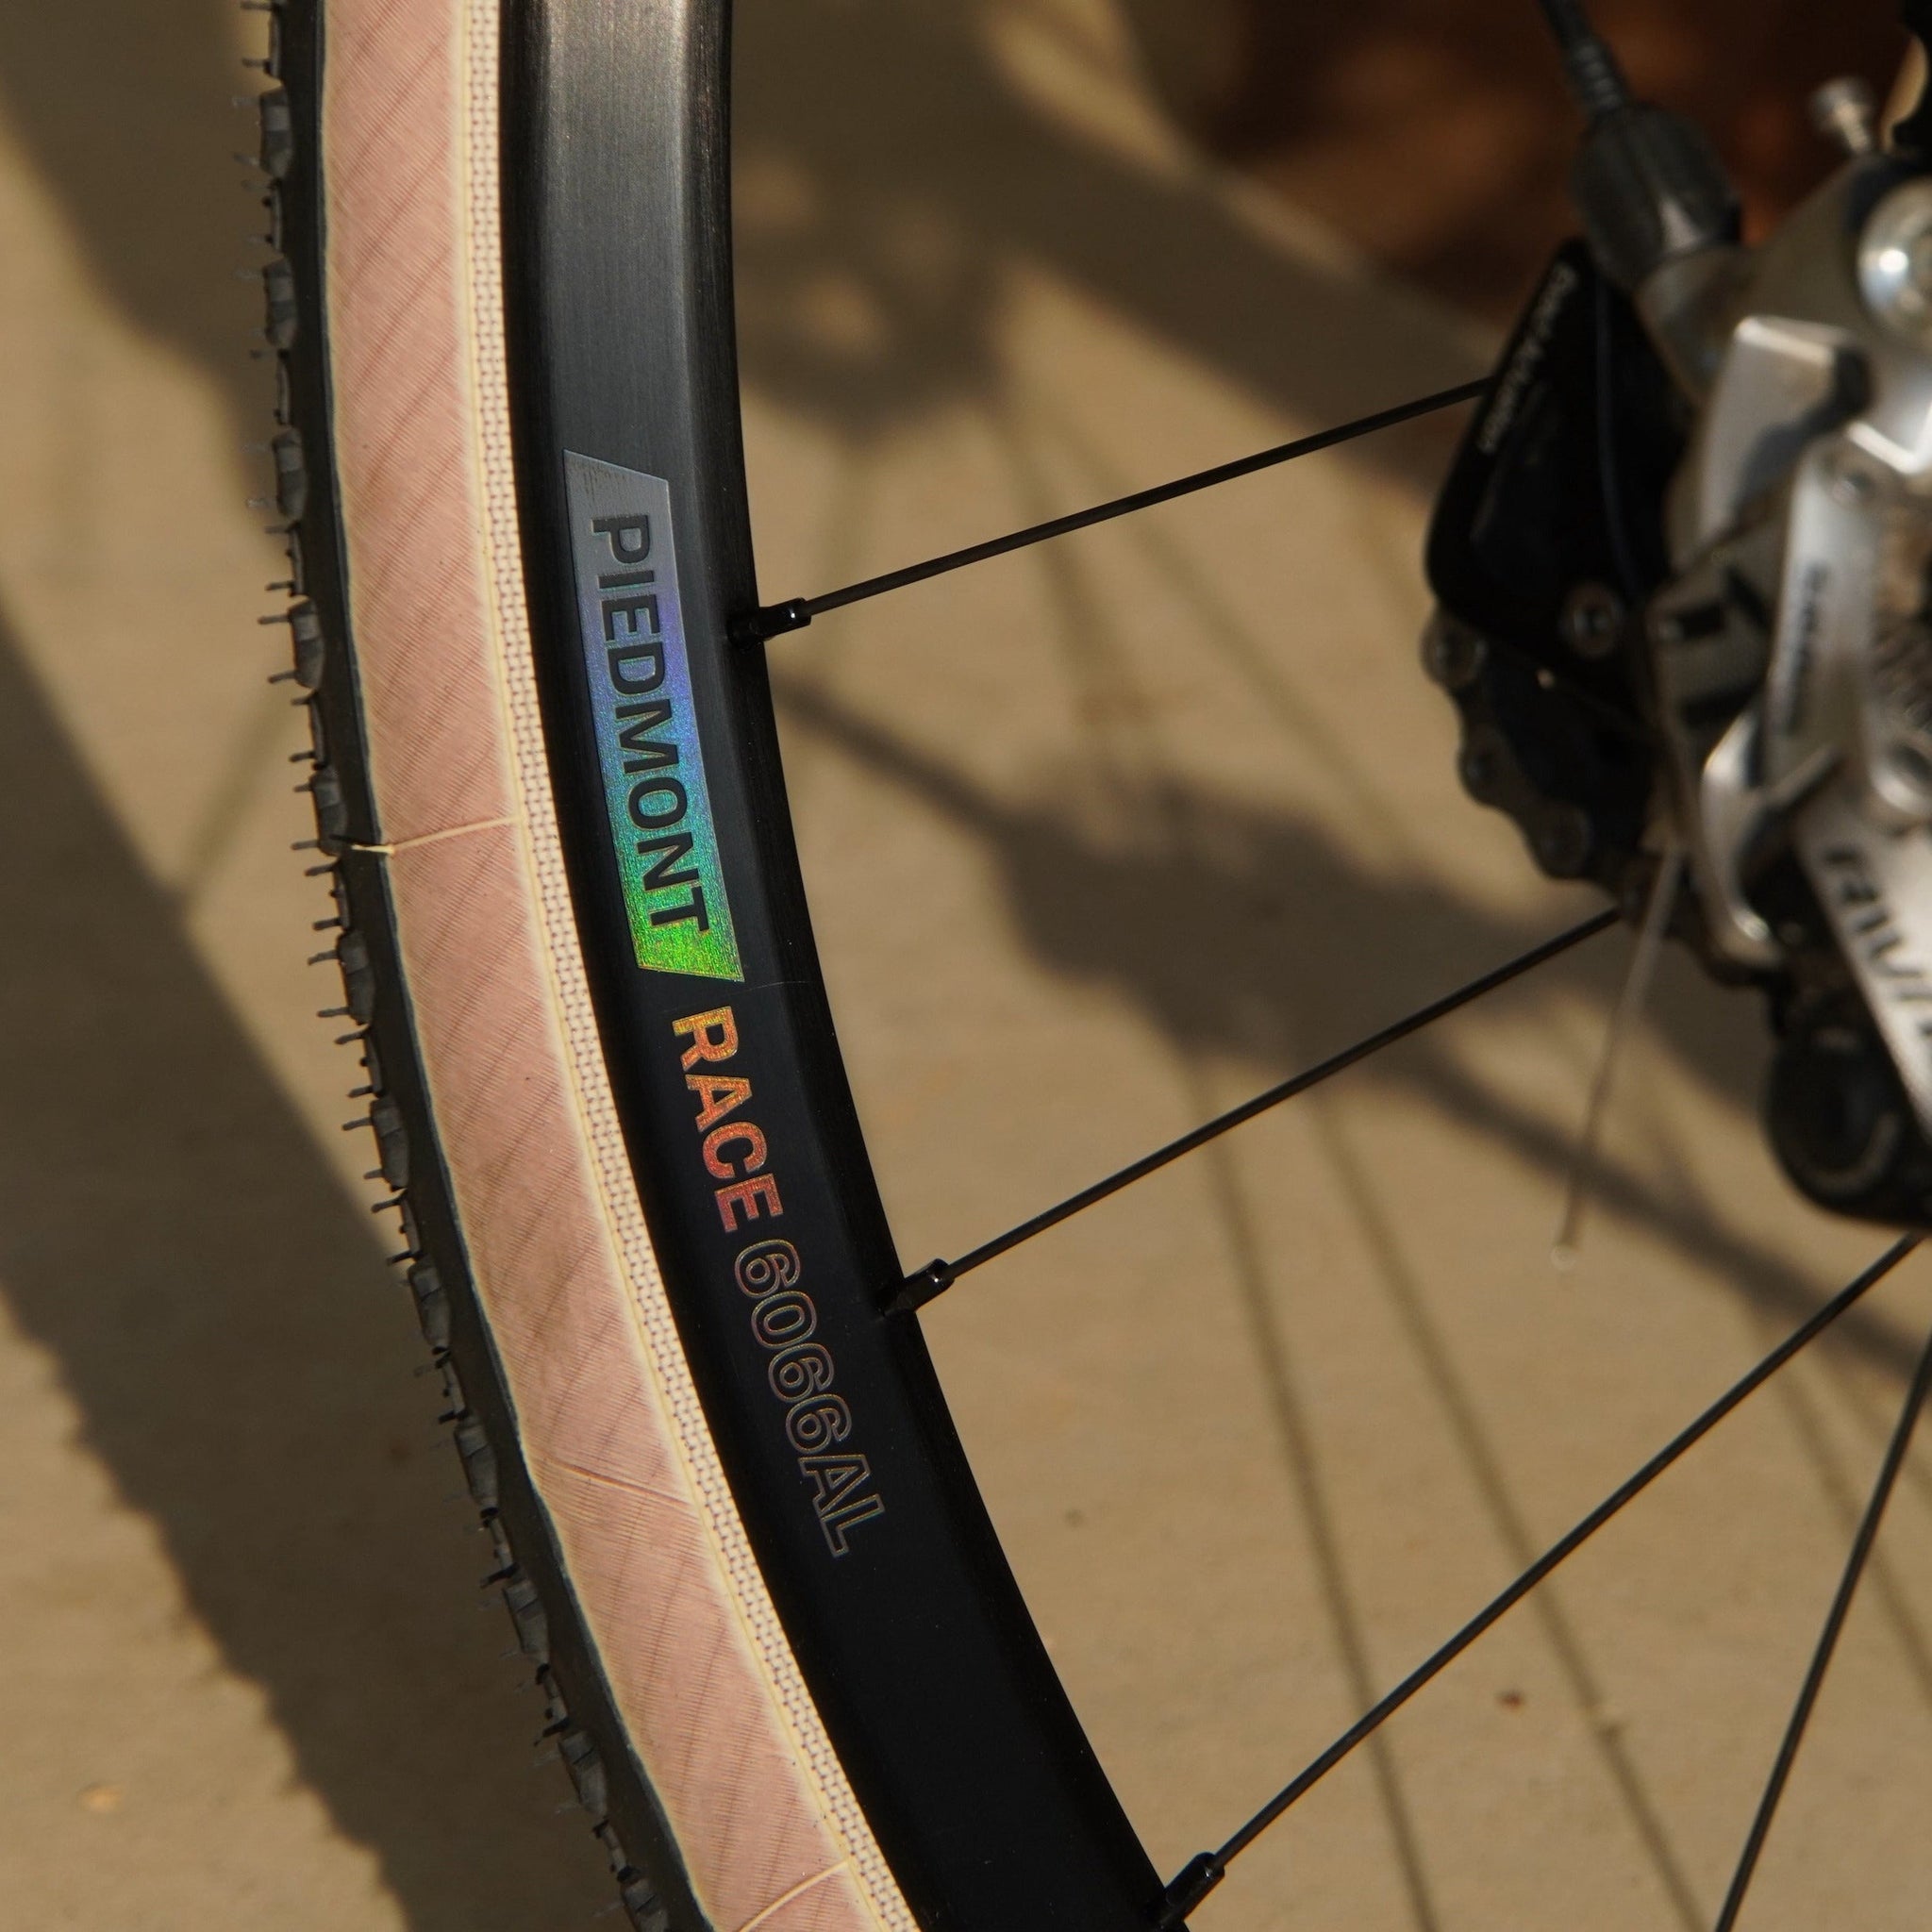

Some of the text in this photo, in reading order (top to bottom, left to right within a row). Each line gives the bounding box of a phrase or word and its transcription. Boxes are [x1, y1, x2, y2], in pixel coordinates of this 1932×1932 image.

[591, 513, 886, 1558] PIEDMONT RACE 6066AL
